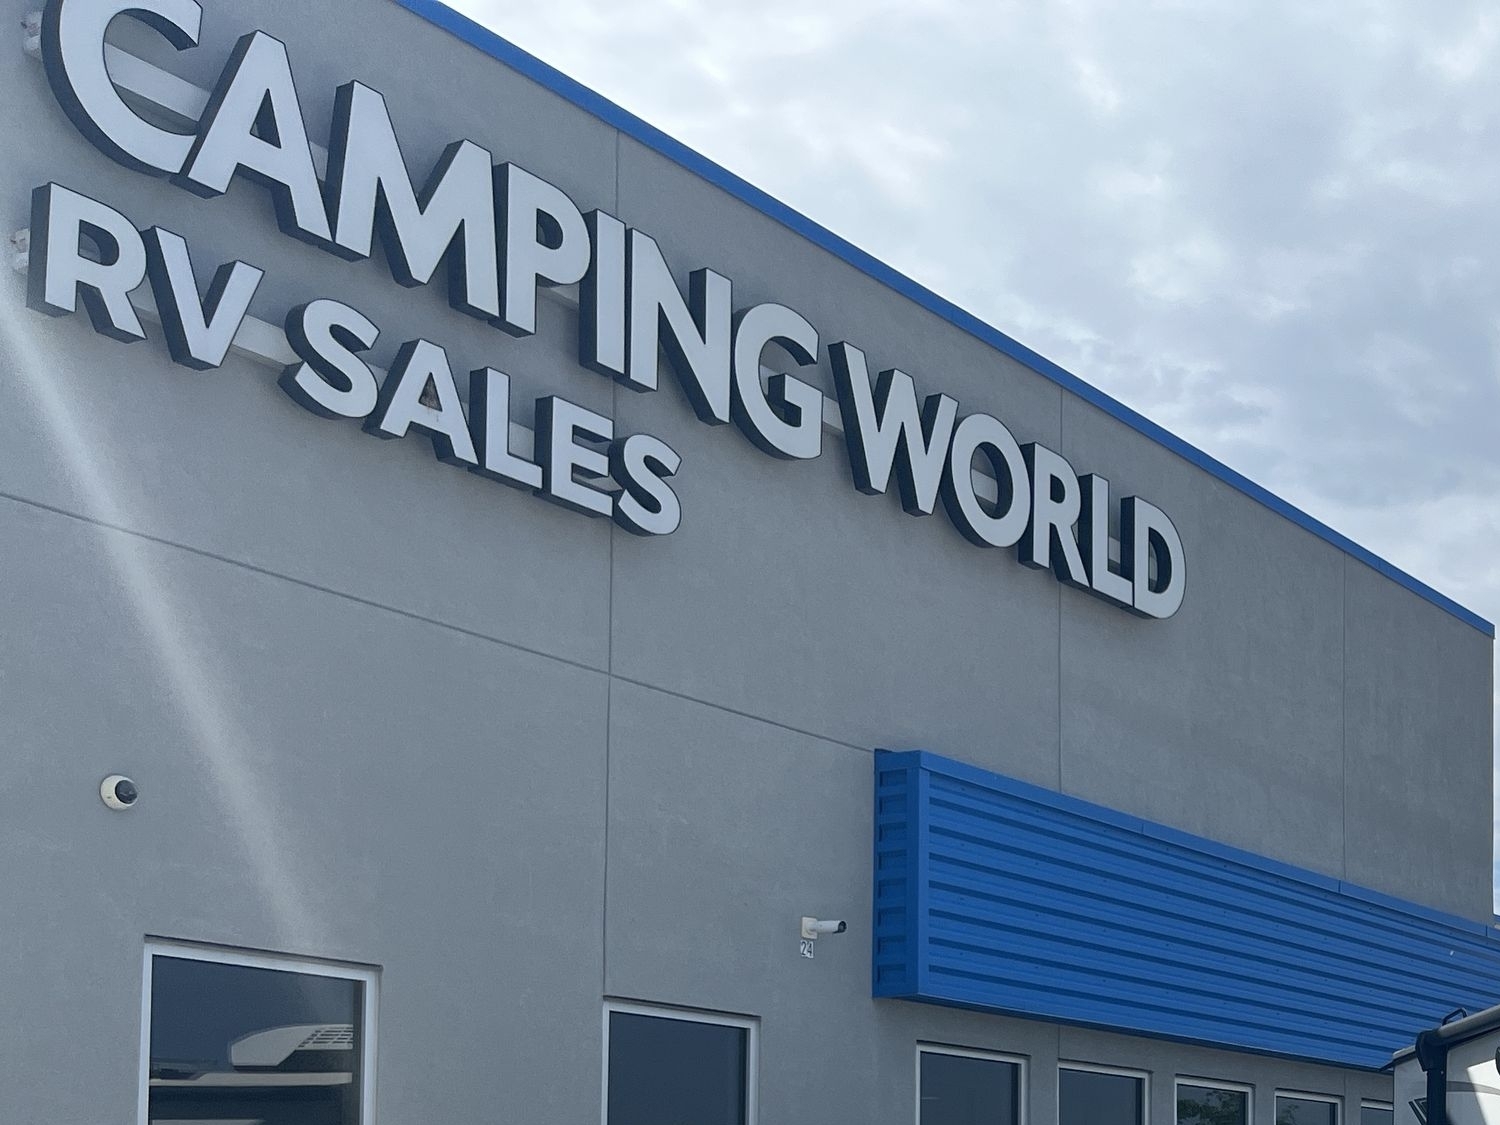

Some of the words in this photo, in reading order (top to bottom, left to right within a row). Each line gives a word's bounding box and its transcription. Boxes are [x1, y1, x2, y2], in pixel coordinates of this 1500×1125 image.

[27, 182, 265, 371] RV
[278, 299, 682, 536] SALES
[42, 0, 823, 460] CAMPING
[828, 341, 1187, 620] WORLD
